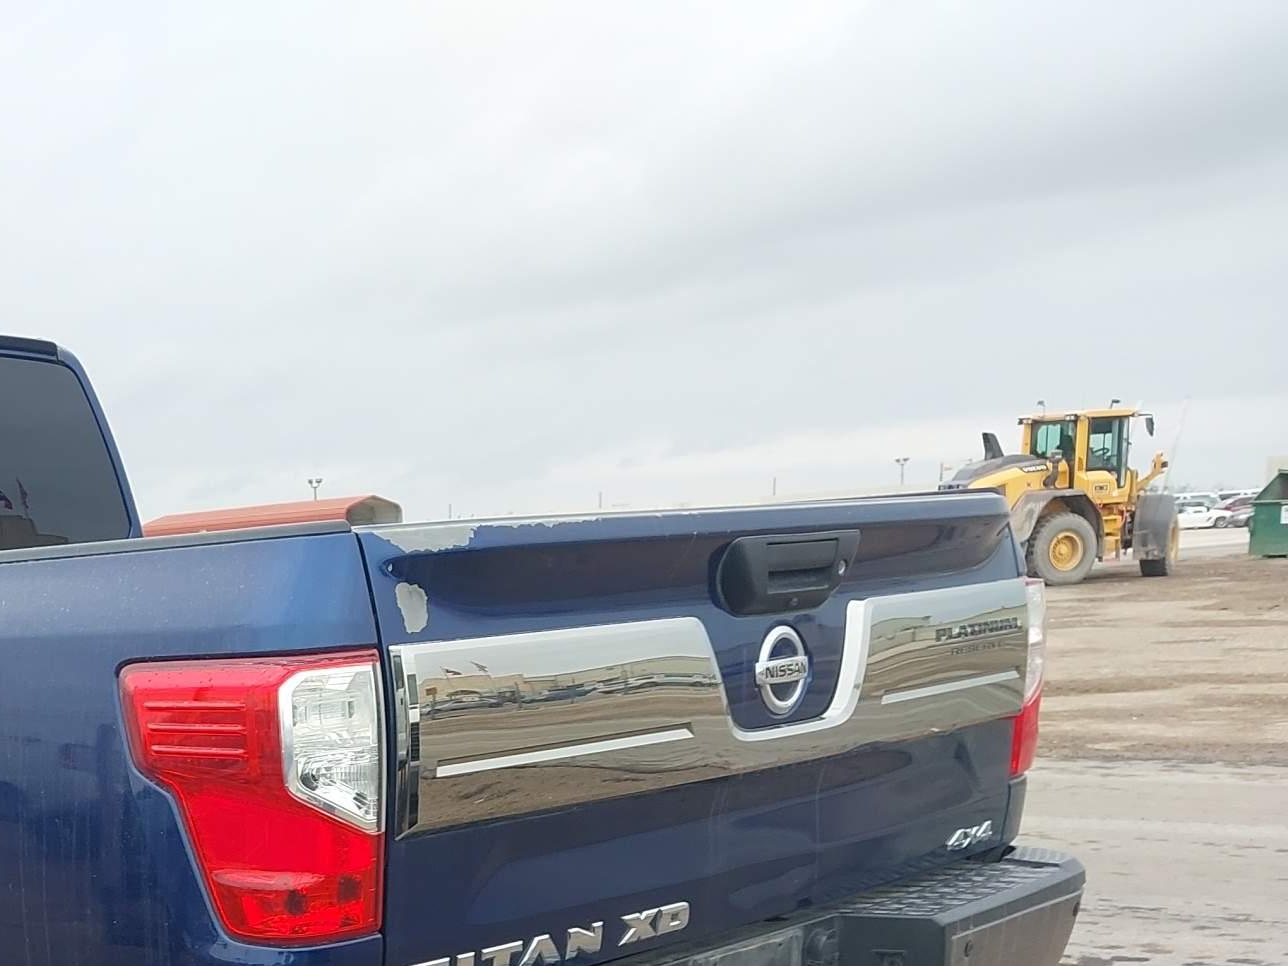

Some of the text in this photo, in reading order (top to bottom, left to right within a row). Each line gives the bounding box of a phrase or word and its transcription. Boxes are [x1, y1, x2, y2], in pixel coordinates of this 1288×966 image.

[935, 617, 1022, 642] PLATINUM
[765, 661, 807, 679] NISSAN
[617, 901, 691, 948] XD
